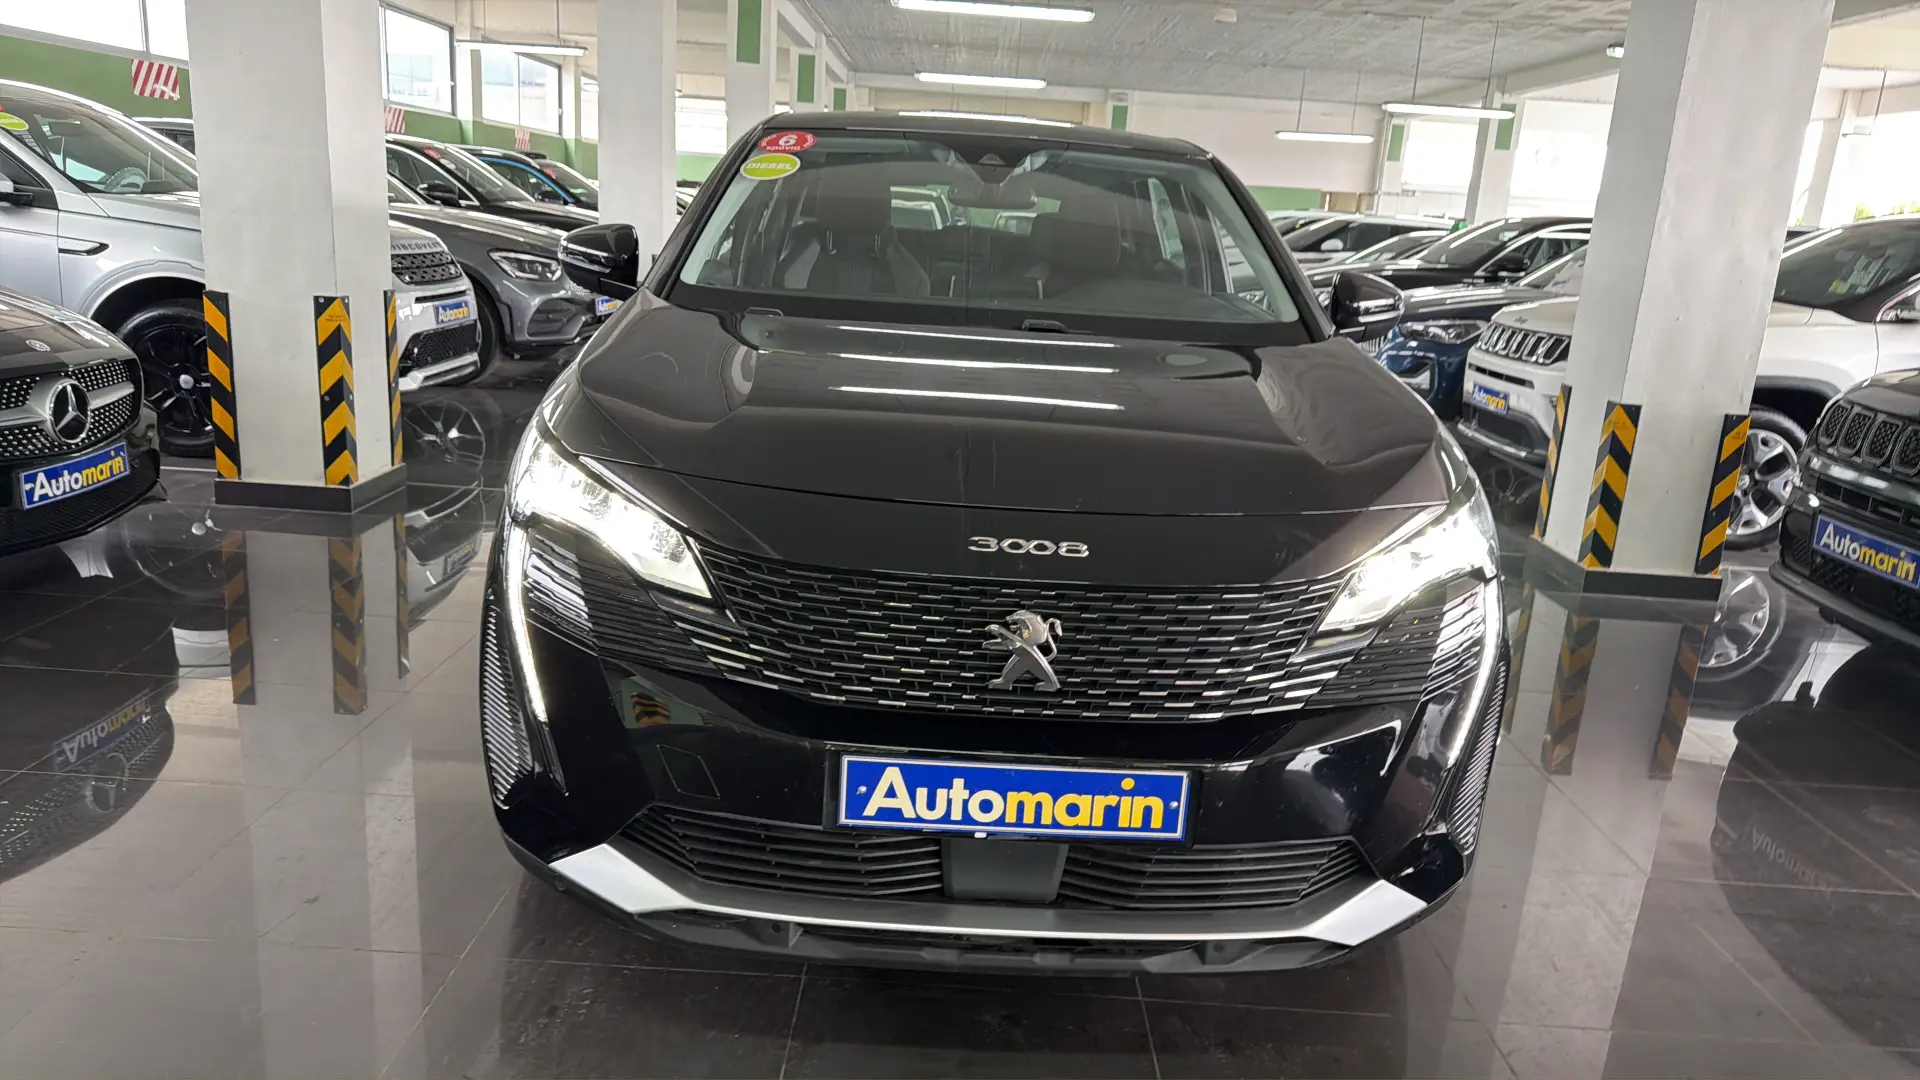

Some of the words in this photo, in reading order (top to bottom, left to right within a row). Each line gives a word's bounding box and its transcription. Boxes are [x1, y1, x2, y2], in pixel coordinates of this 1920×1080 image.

[779, 135, 798, 146] 6
[746, 162, 793, 170] DIESEL
[33, 450, 124, 502] Automarin
[968, 536, 1089, 557] 3008
[1820, 522, 1916, 584] Automarin
[863, 766, 1164, 829] Automarin
